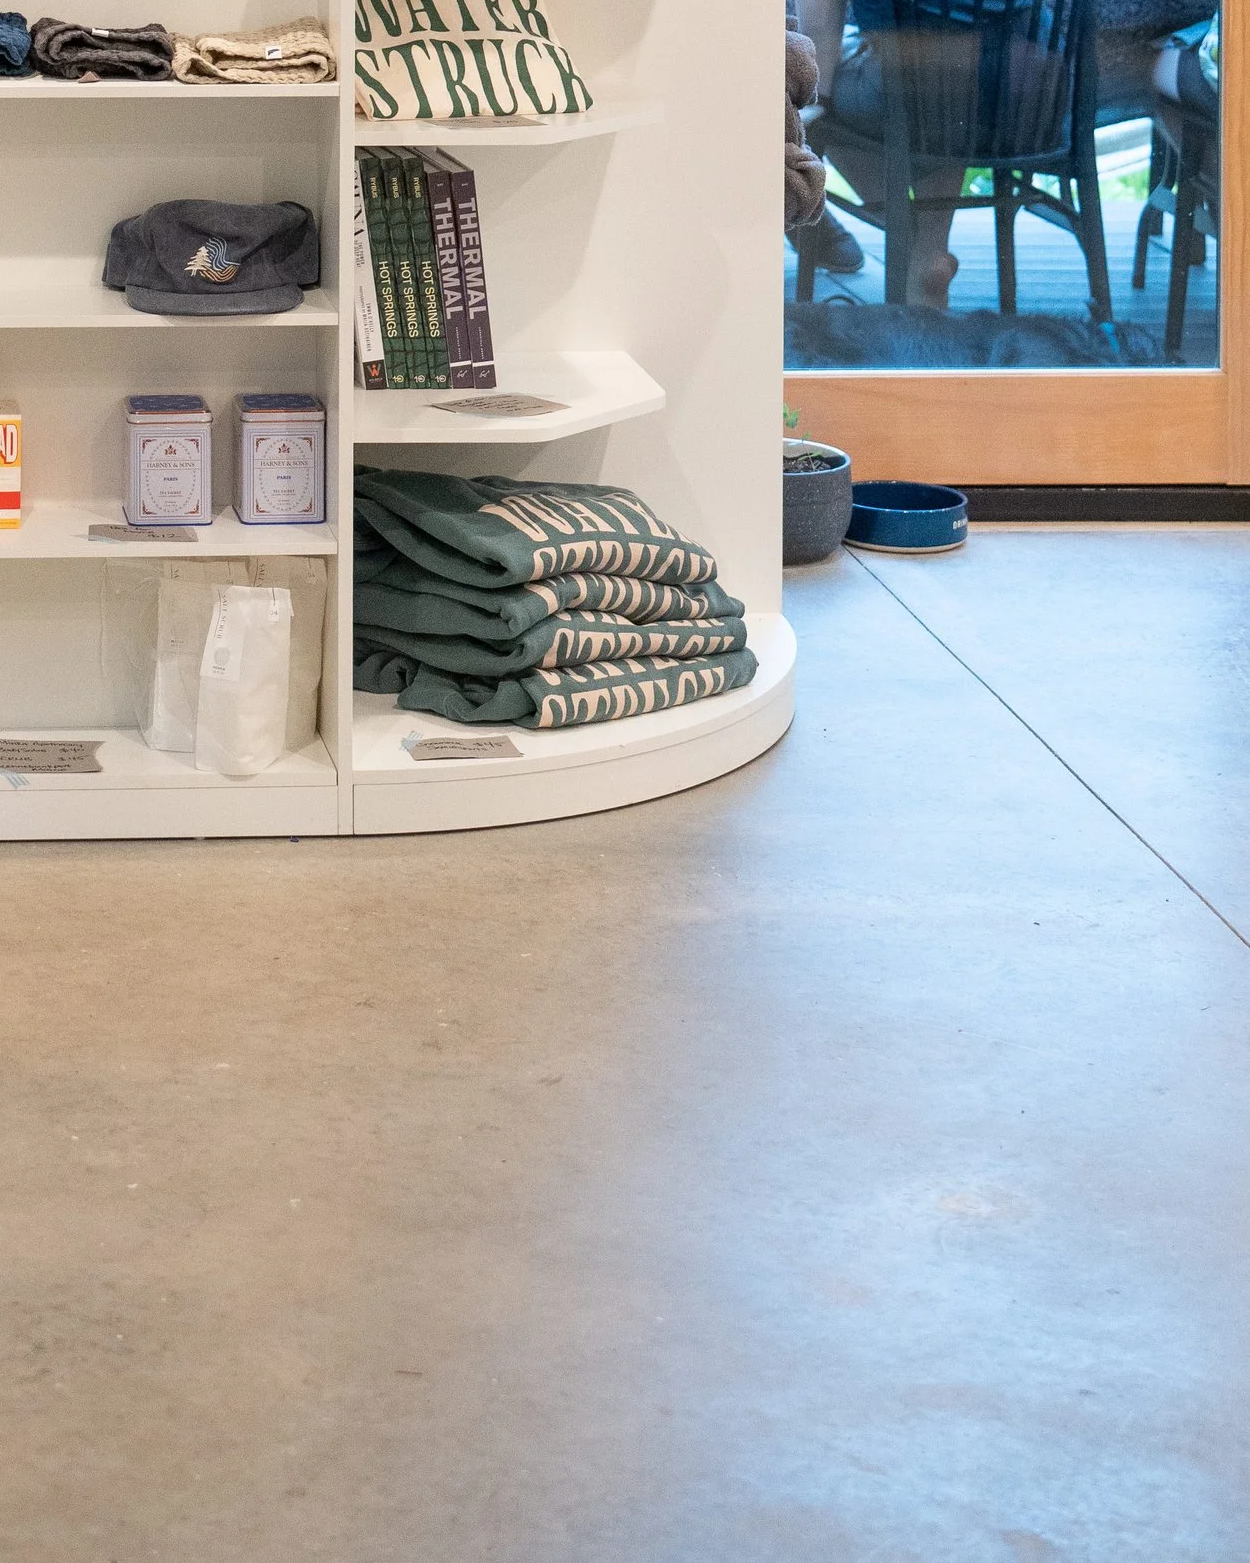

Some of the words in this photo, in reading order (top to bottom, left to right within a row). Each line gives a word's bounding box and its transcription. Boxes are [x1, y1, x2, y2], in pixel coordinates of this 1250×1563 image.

[355, 39, 593, 118] STRUCK
[370, 177, 378, 199] RYBUS
[391, 177, 399, 199] RYBUS
[413, 177, 421, 198] RYBUS
[379, 261, 391, 284] HOT
[401, 261, 413, 285] HOT
[422, 261, 434, 284] HOT
[434, 197, 463, 319] THERMAL
[458, 197, 486, 319] THERMAL
[382, 287, 398, 338] SPRINGS
[404, 287, 419, 338] SPRINGS
[425, 287, 440, 338] SPRINGS
